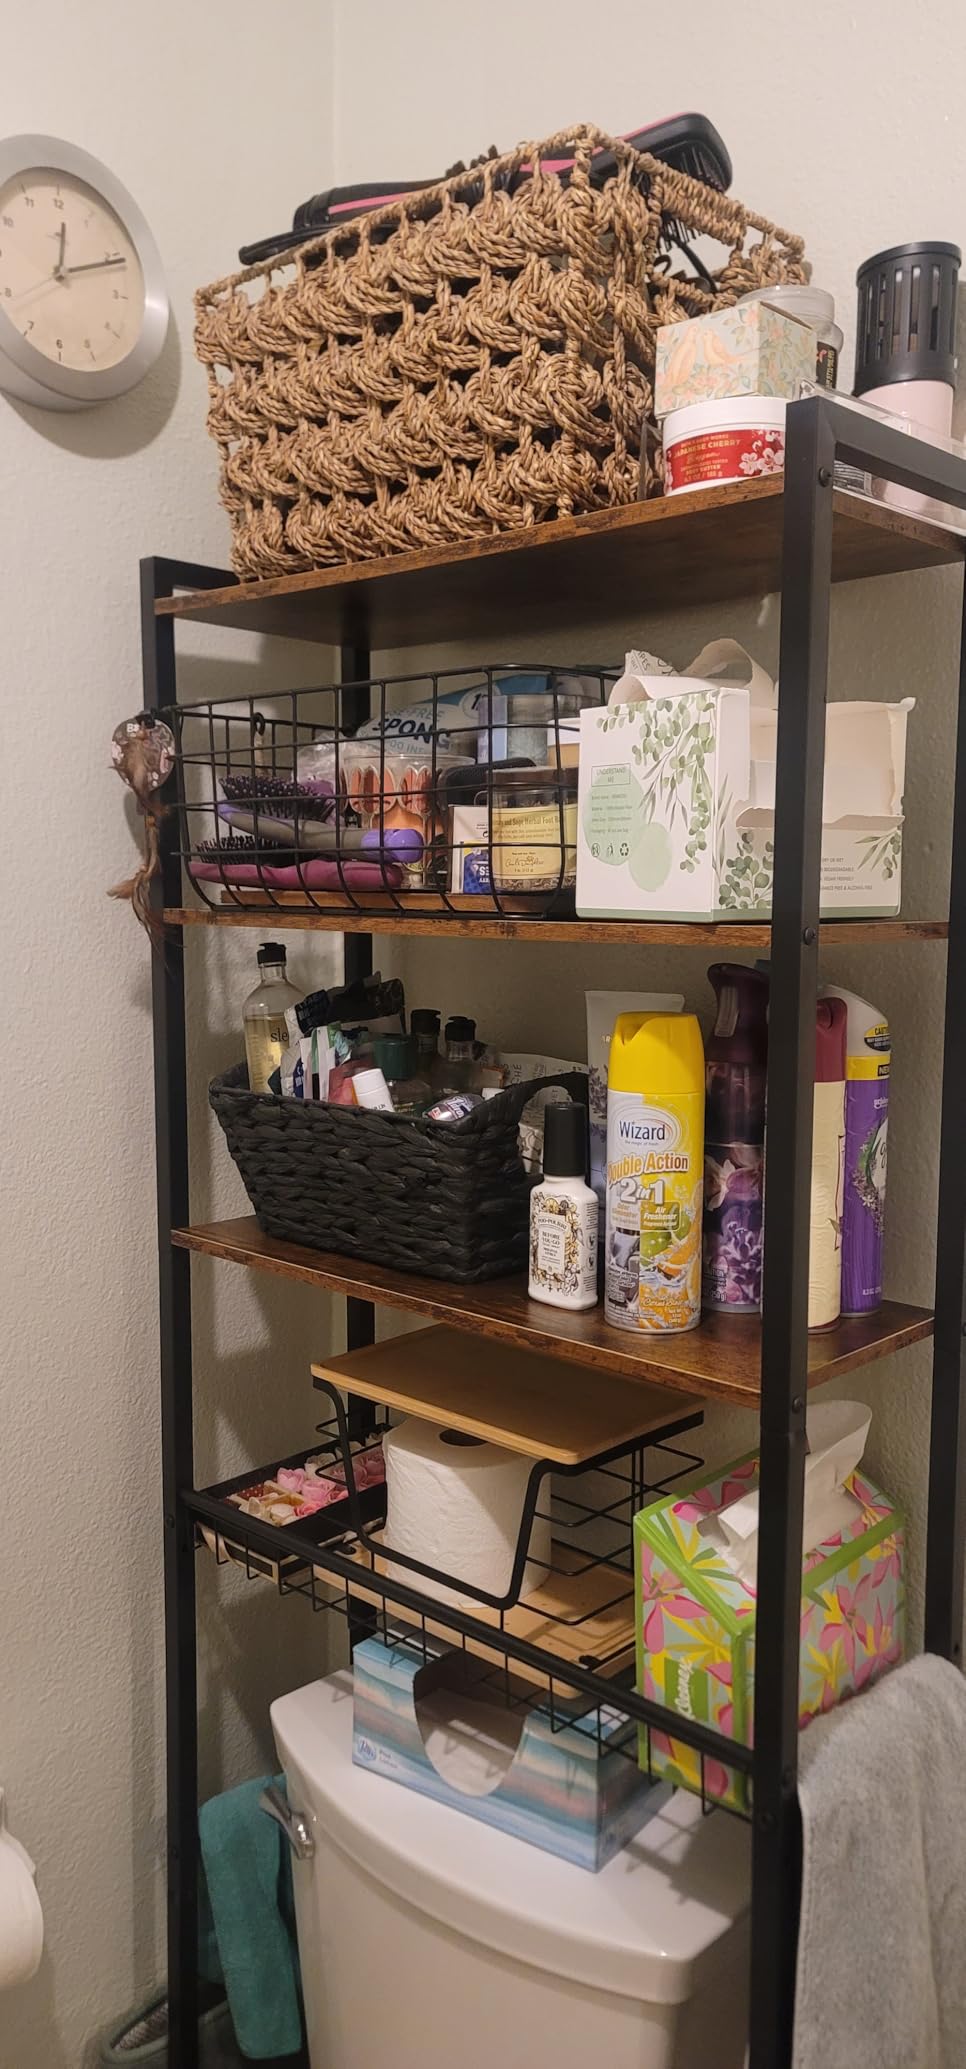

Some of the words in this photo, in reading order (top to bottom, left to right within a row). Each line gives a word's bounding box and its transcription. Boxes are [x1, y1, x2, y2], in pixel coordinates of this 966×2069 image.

[54, 199, 64, 210] 12
[708, 439, 740, 449] CHERRY
[619, 1121, 666, 1141] Wizard
[607, 1154, 642, 1184] Double
[645, 1152, 689, 1171] Action
[644, 1212, 677, 1220] Freshener
